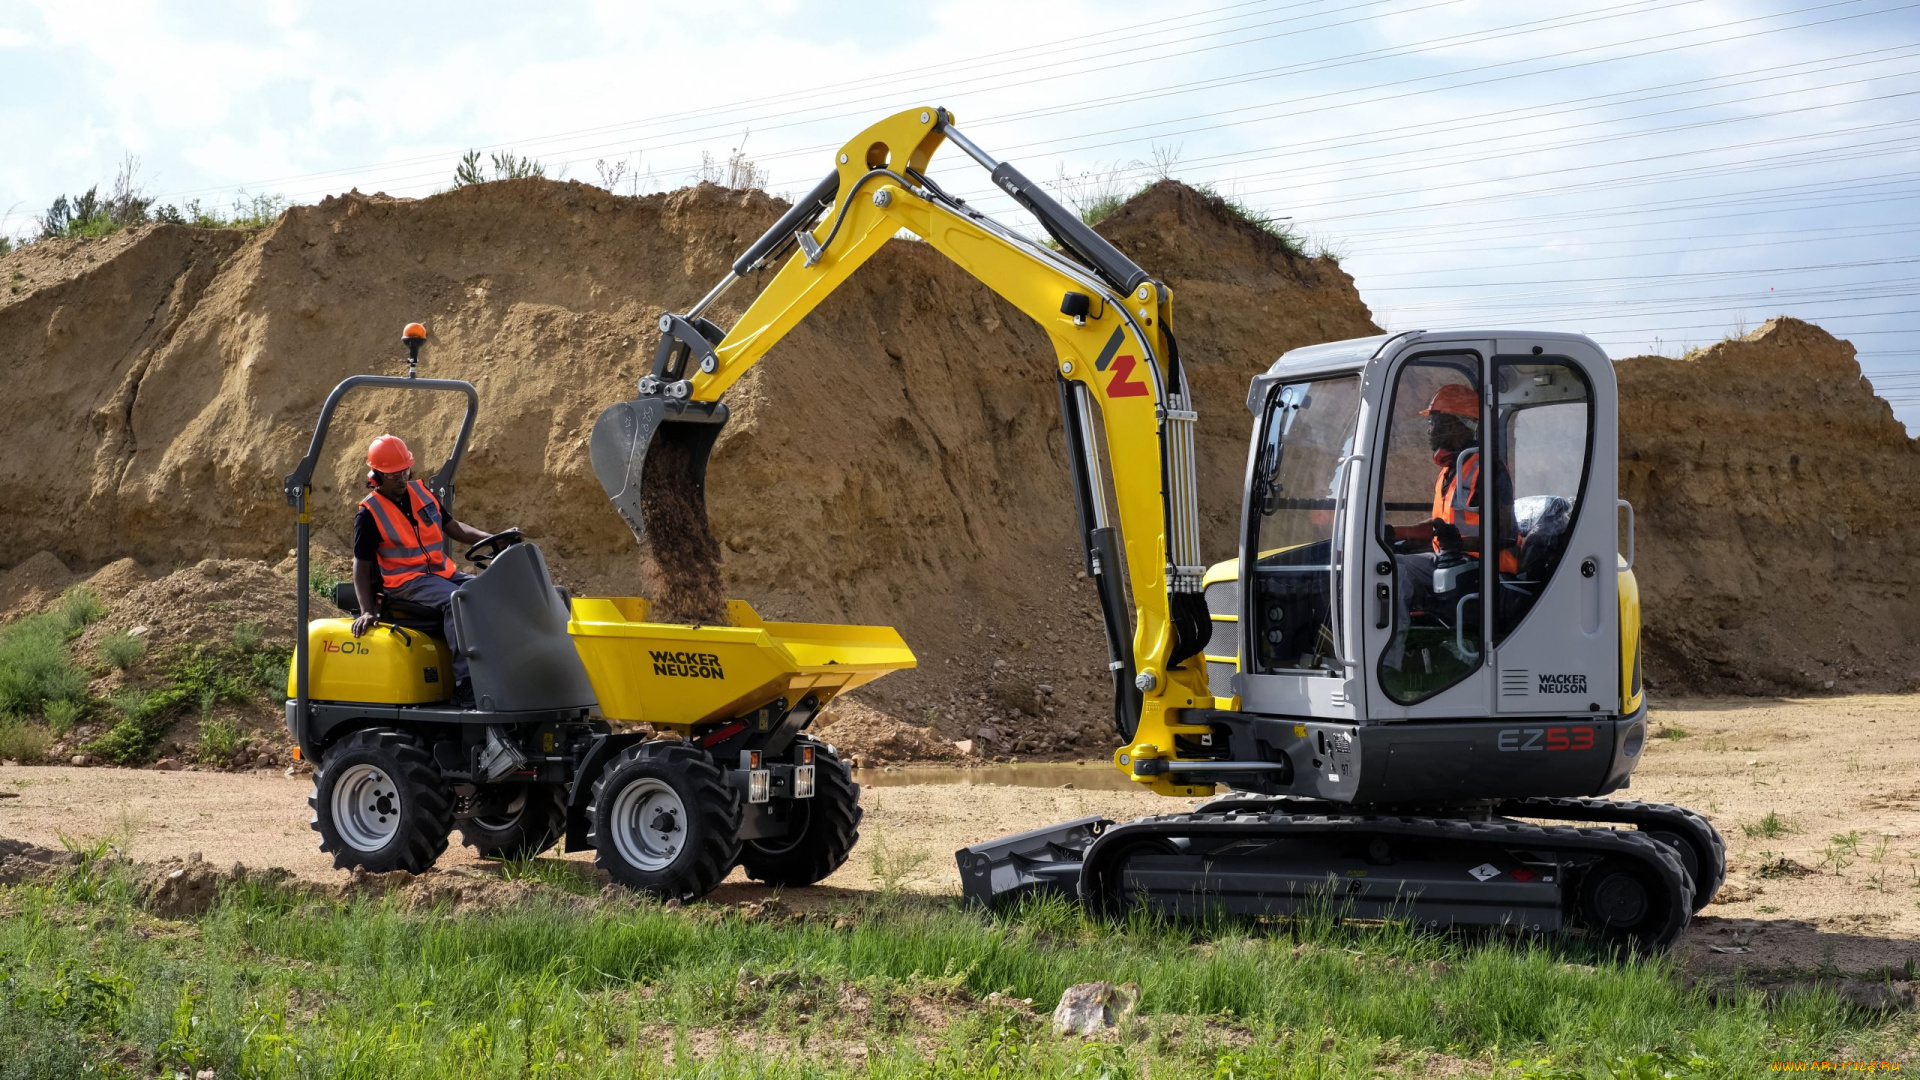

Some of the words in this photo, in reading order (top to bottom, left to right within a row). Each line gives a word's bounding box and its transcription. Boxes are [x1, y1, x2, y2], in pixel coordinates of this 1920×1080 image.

[648, 650, 721, 667] WACKER
[653, 663, 724, 680] NEUSON
[1538, 674, 1587, 684] WACKER
[1538, 684, 1587, 694] NEUSON
[1497, 727, 1595, 752] EZ53
